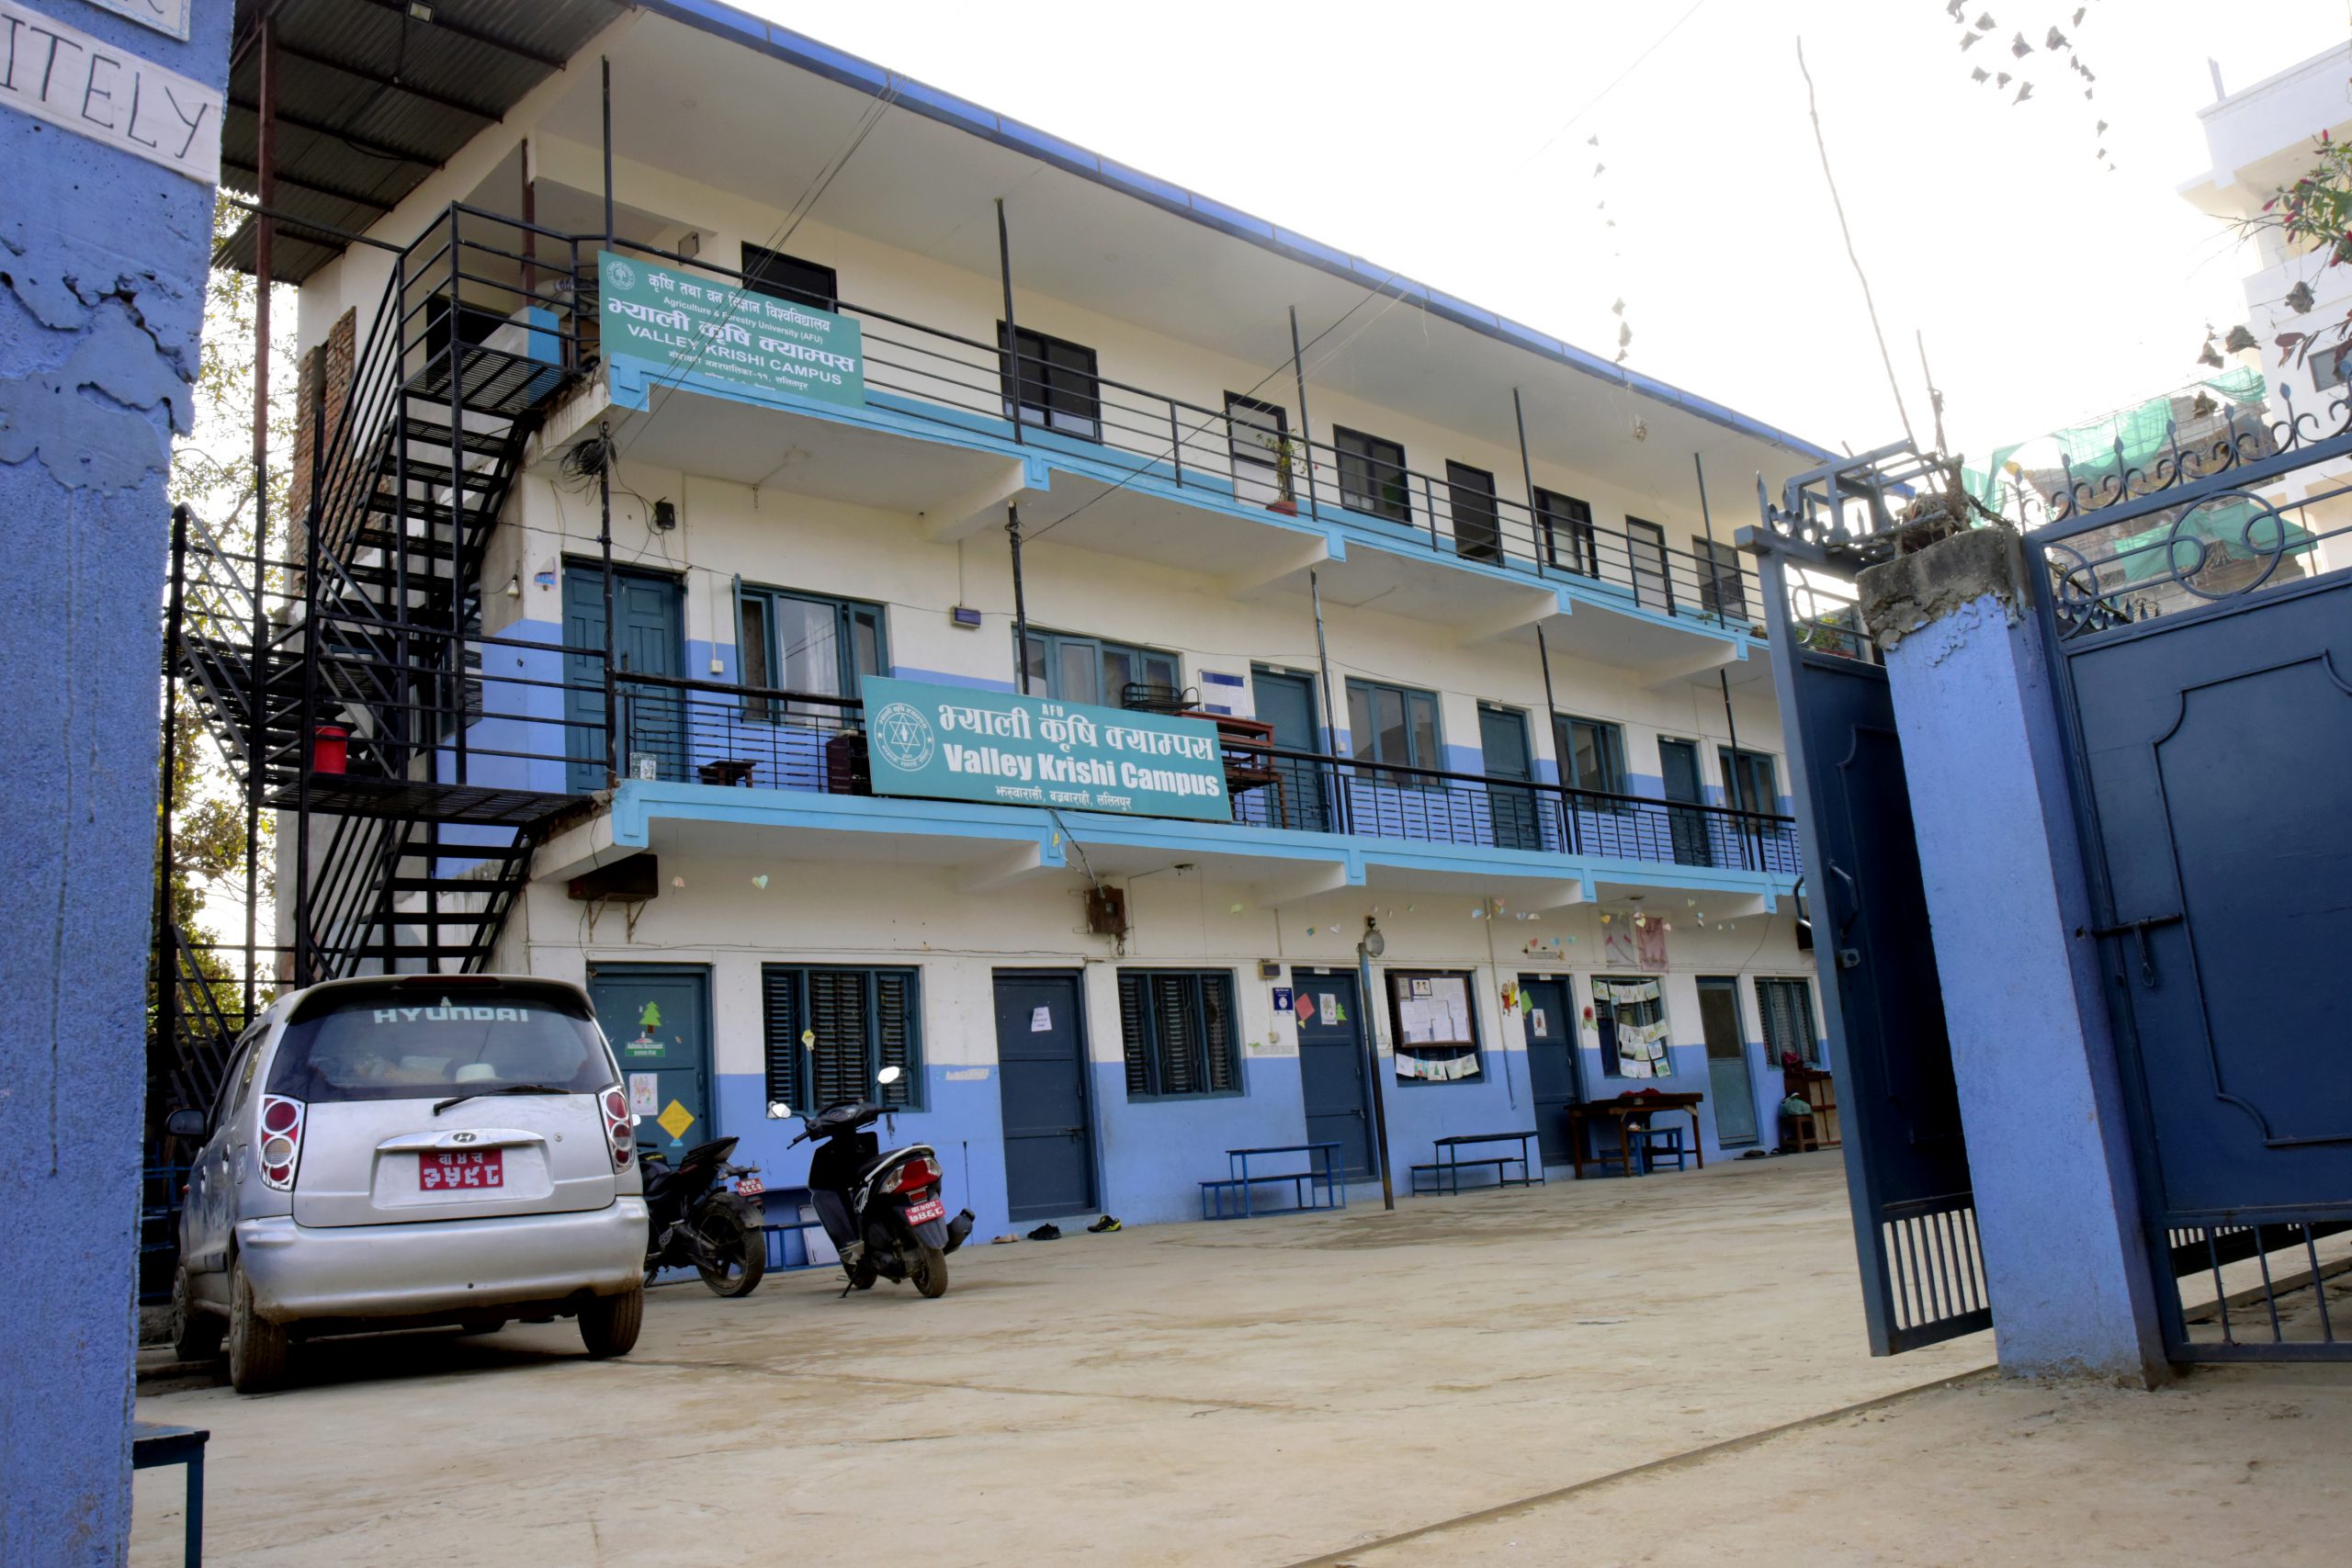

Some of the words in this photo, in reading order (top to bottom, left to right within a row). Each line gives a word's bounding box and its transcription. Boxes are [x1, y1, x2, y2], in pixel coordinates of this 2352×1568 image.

[648, 273, 675, 293] कृषि
[680, 282, 701, 299] तथा
[707, 289, 723, 304] वन
[765, 301, 831, 333] विश्वविद्यालय
[663, 297, 712, 315] Agriculture
[722, 311, 757, 328] Forestry
[759, 320, 799, 338] University
[800, 331, 823, 345] (AFU)
[608, 297, 691, 332] भ्याली
[698, 321, 752, 347] कृषि
[759, 335, 855, 373] क्याम्पस
[627, 323, 699, 351] VALLEY
[705, 343, 764, 367] KRISHI
[769, 359, 842, 385] CAMPUS
[938, 704, 1033, 740] भ्याली
[1038, 713, 1099, 753] कृषि
[1103, 724, 1216, 761] क्याम्पस
[1041, 704, 1064, 717] AFU
[943, 743, 1033, 782] Valley
[1037, 752, 1117, 787] Krishi
[1120, 761, 1221, 797] Campus
[1096, 791, 1132, 811] ललितपुर
